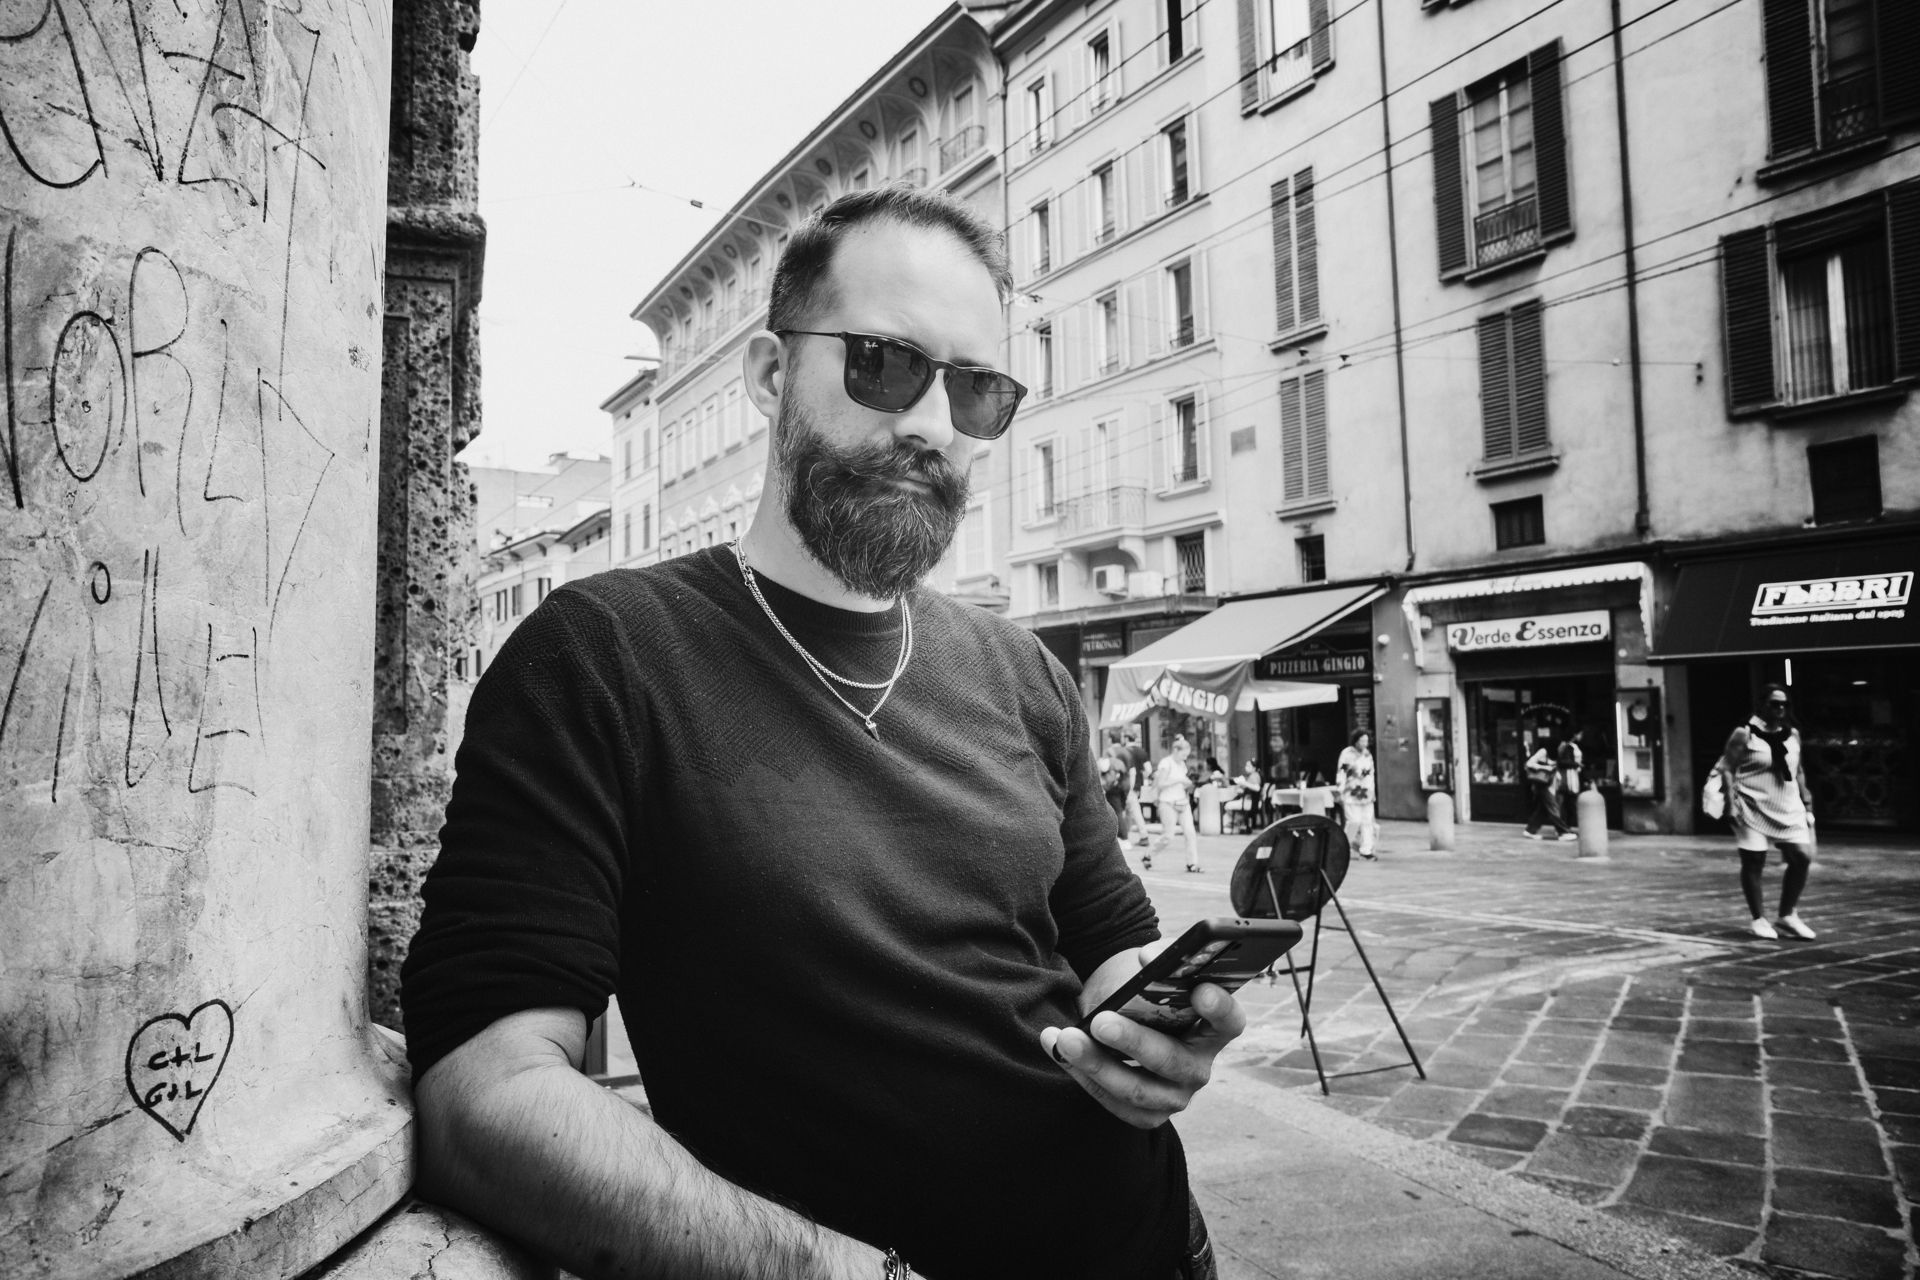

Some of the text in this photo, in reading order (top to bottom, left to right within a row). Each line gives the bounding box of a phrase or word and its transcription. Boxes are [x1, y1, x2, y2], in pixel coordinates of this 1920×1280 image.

[1761, 576, 1904, 607] FABBRI
[1452, 620, 1602, 646] Verde Essenza
[1270, 656, 1365, 675] PIZZERIA GINGIO
[1160, 679, 1229, 715] GINGIO
